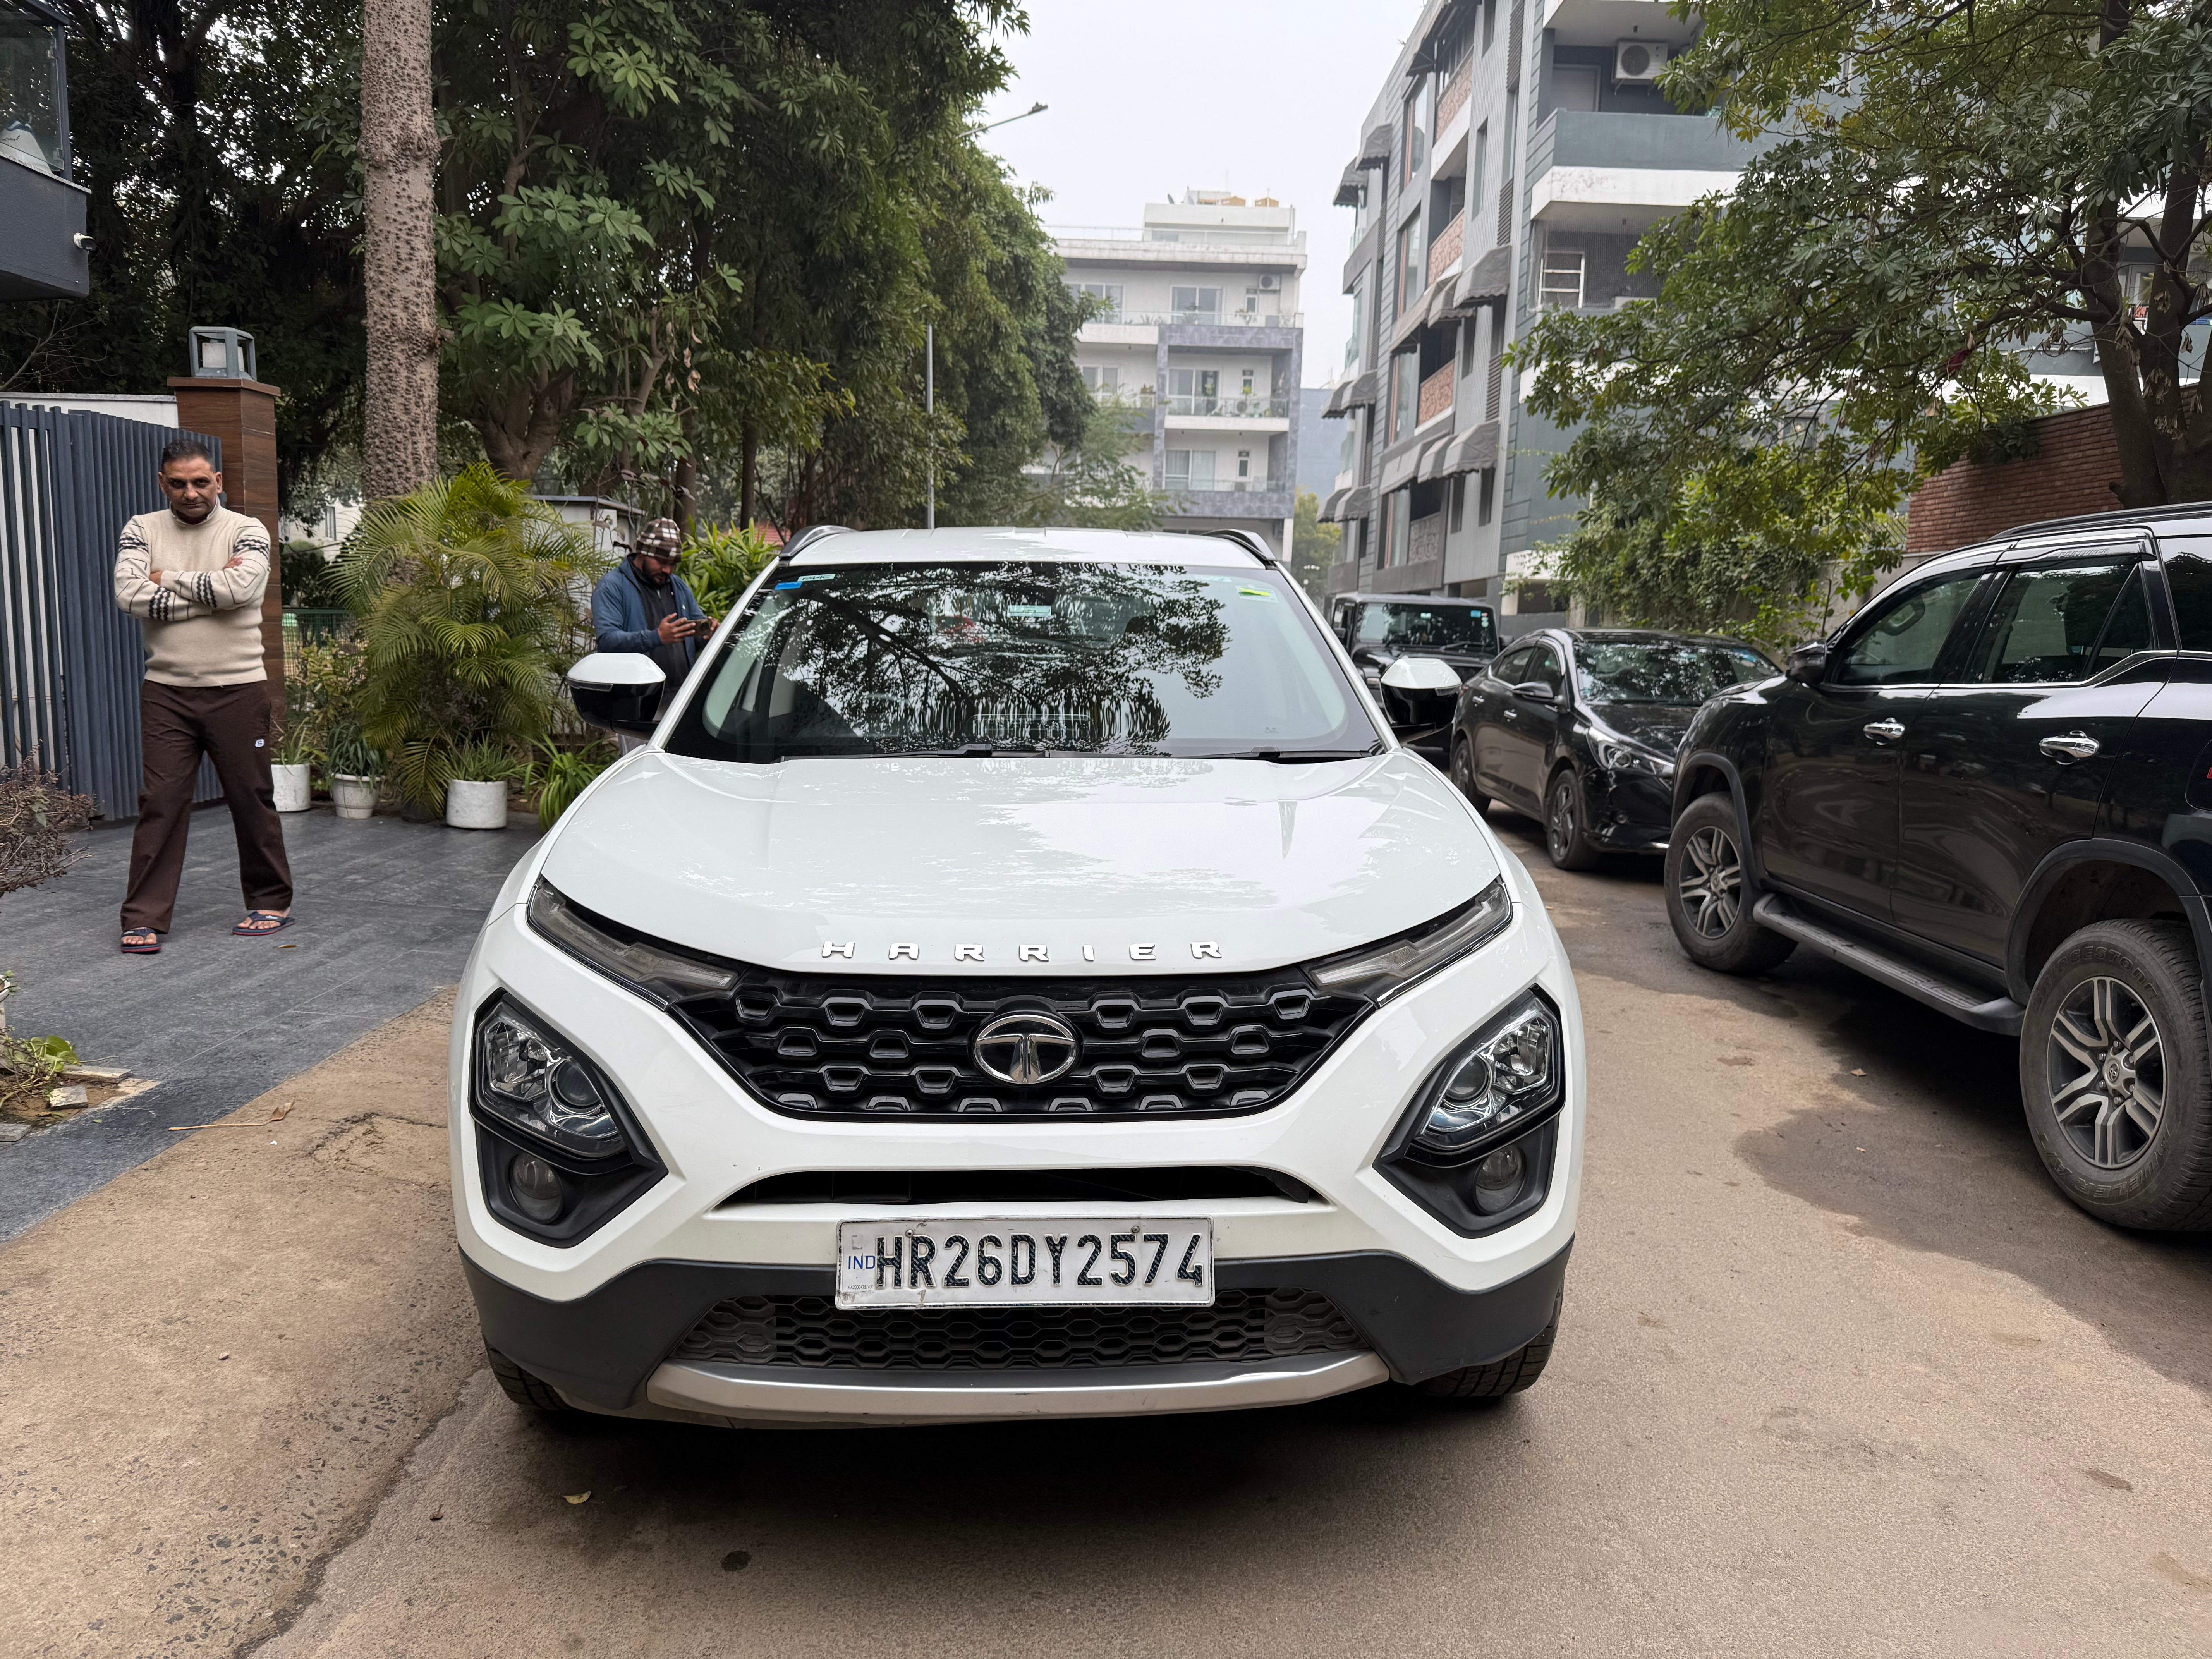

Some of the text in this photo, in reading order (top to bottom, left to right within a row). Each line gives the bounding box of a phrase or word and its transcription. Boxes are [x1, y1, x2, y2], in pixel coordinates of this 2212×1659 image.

[2057, 548, 2109, 558] FORTUNER
[821, 940, 1223, 962] HARRIER
[848, 1233, 1203, 1289] IND HR26DY2574
